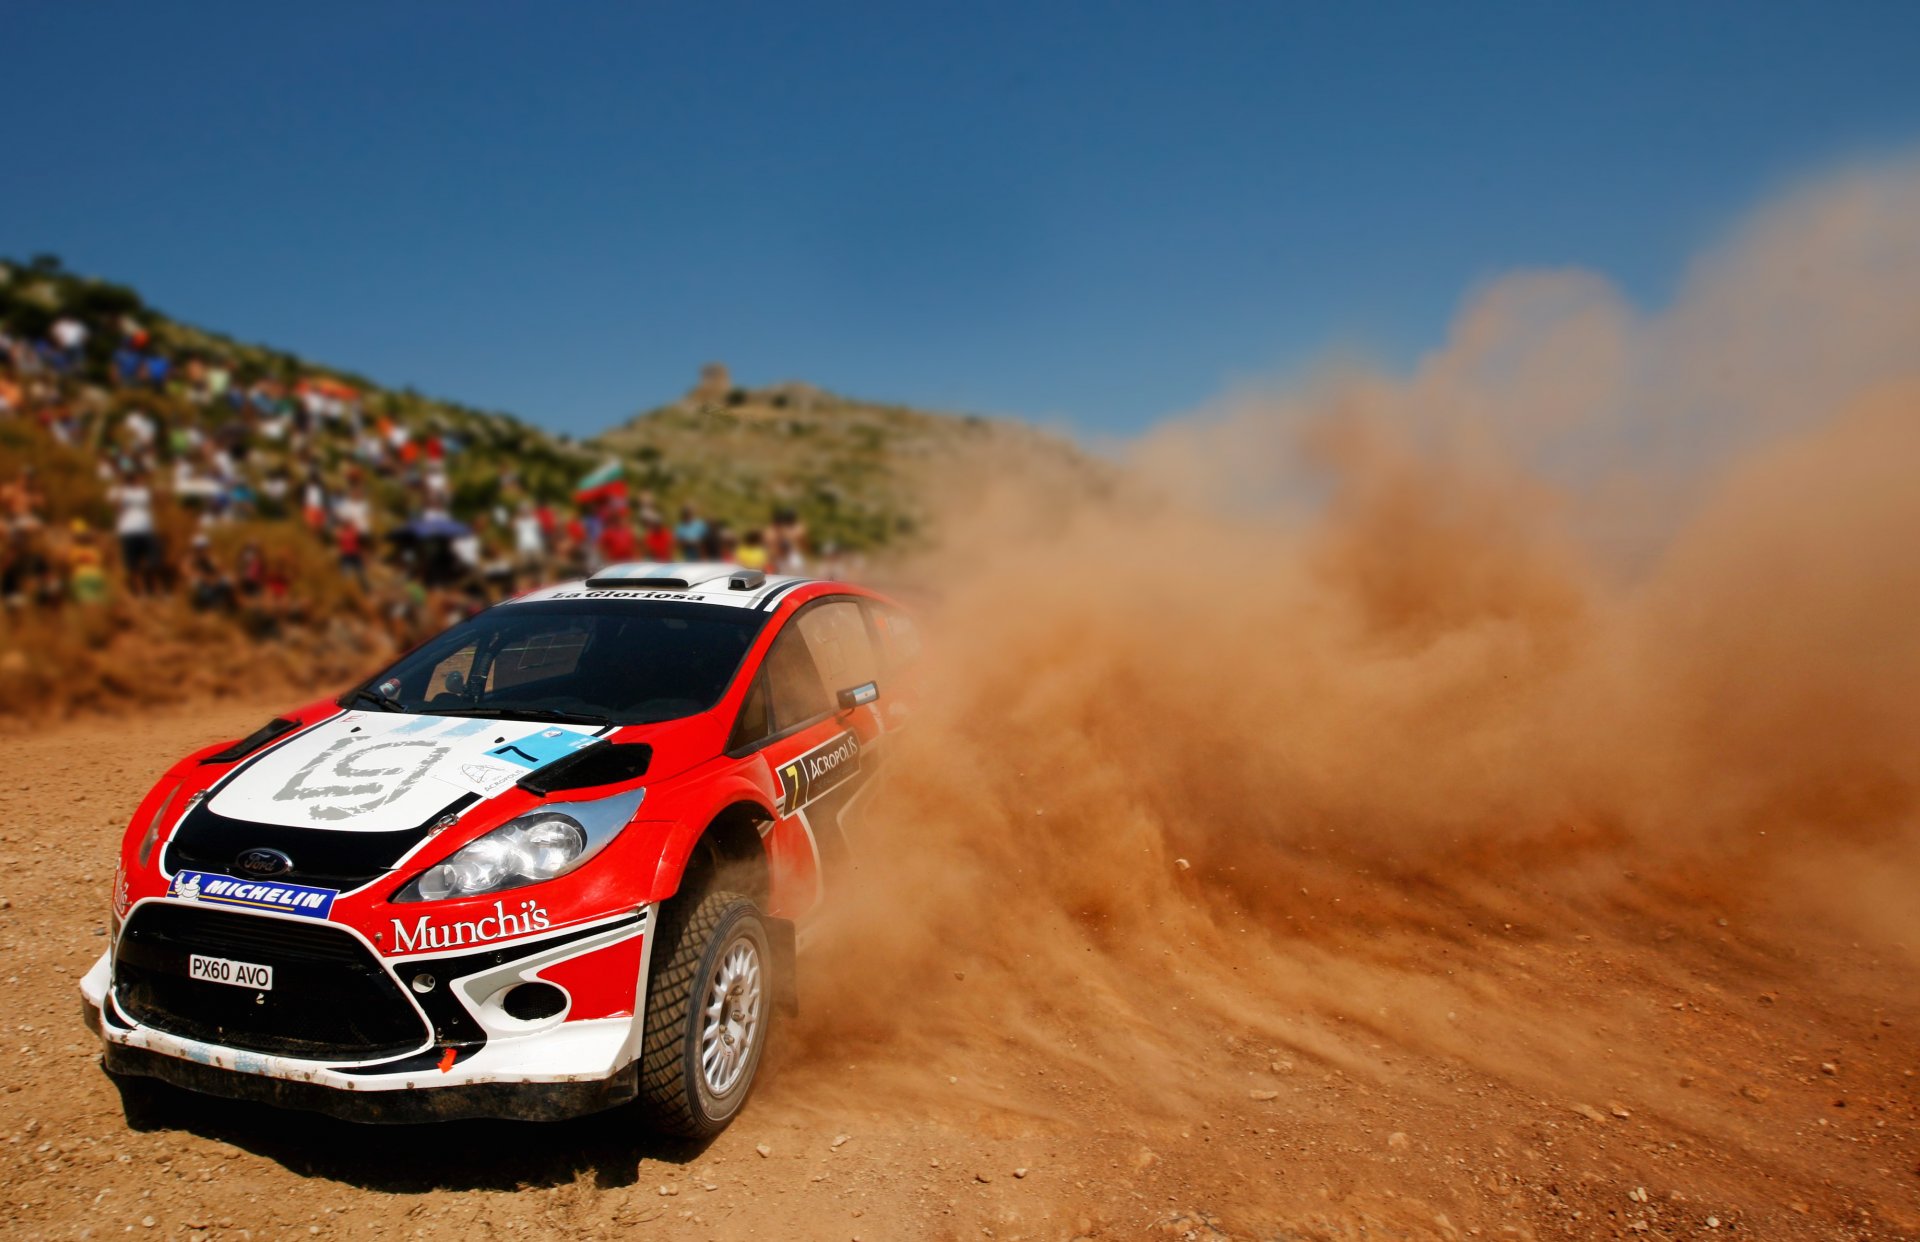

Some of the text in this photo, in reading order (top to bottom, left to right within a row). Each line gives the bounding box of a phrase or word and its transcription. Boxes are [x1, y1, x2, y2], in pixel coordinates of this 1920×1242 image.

[550, 591, 706, 602] La Gloriosa
[493, 745, 540, 763] 7
[785, 764, 799, 811] 7
[810, 735, 858, 780] ACROPOLIS
[244, 852, 278, 871] Ford
[203, 880, 328, 909] MICHELIN
[390, 900, 550, 953] Munchi's
[193, 958, 269, 987] PX60 AVO
